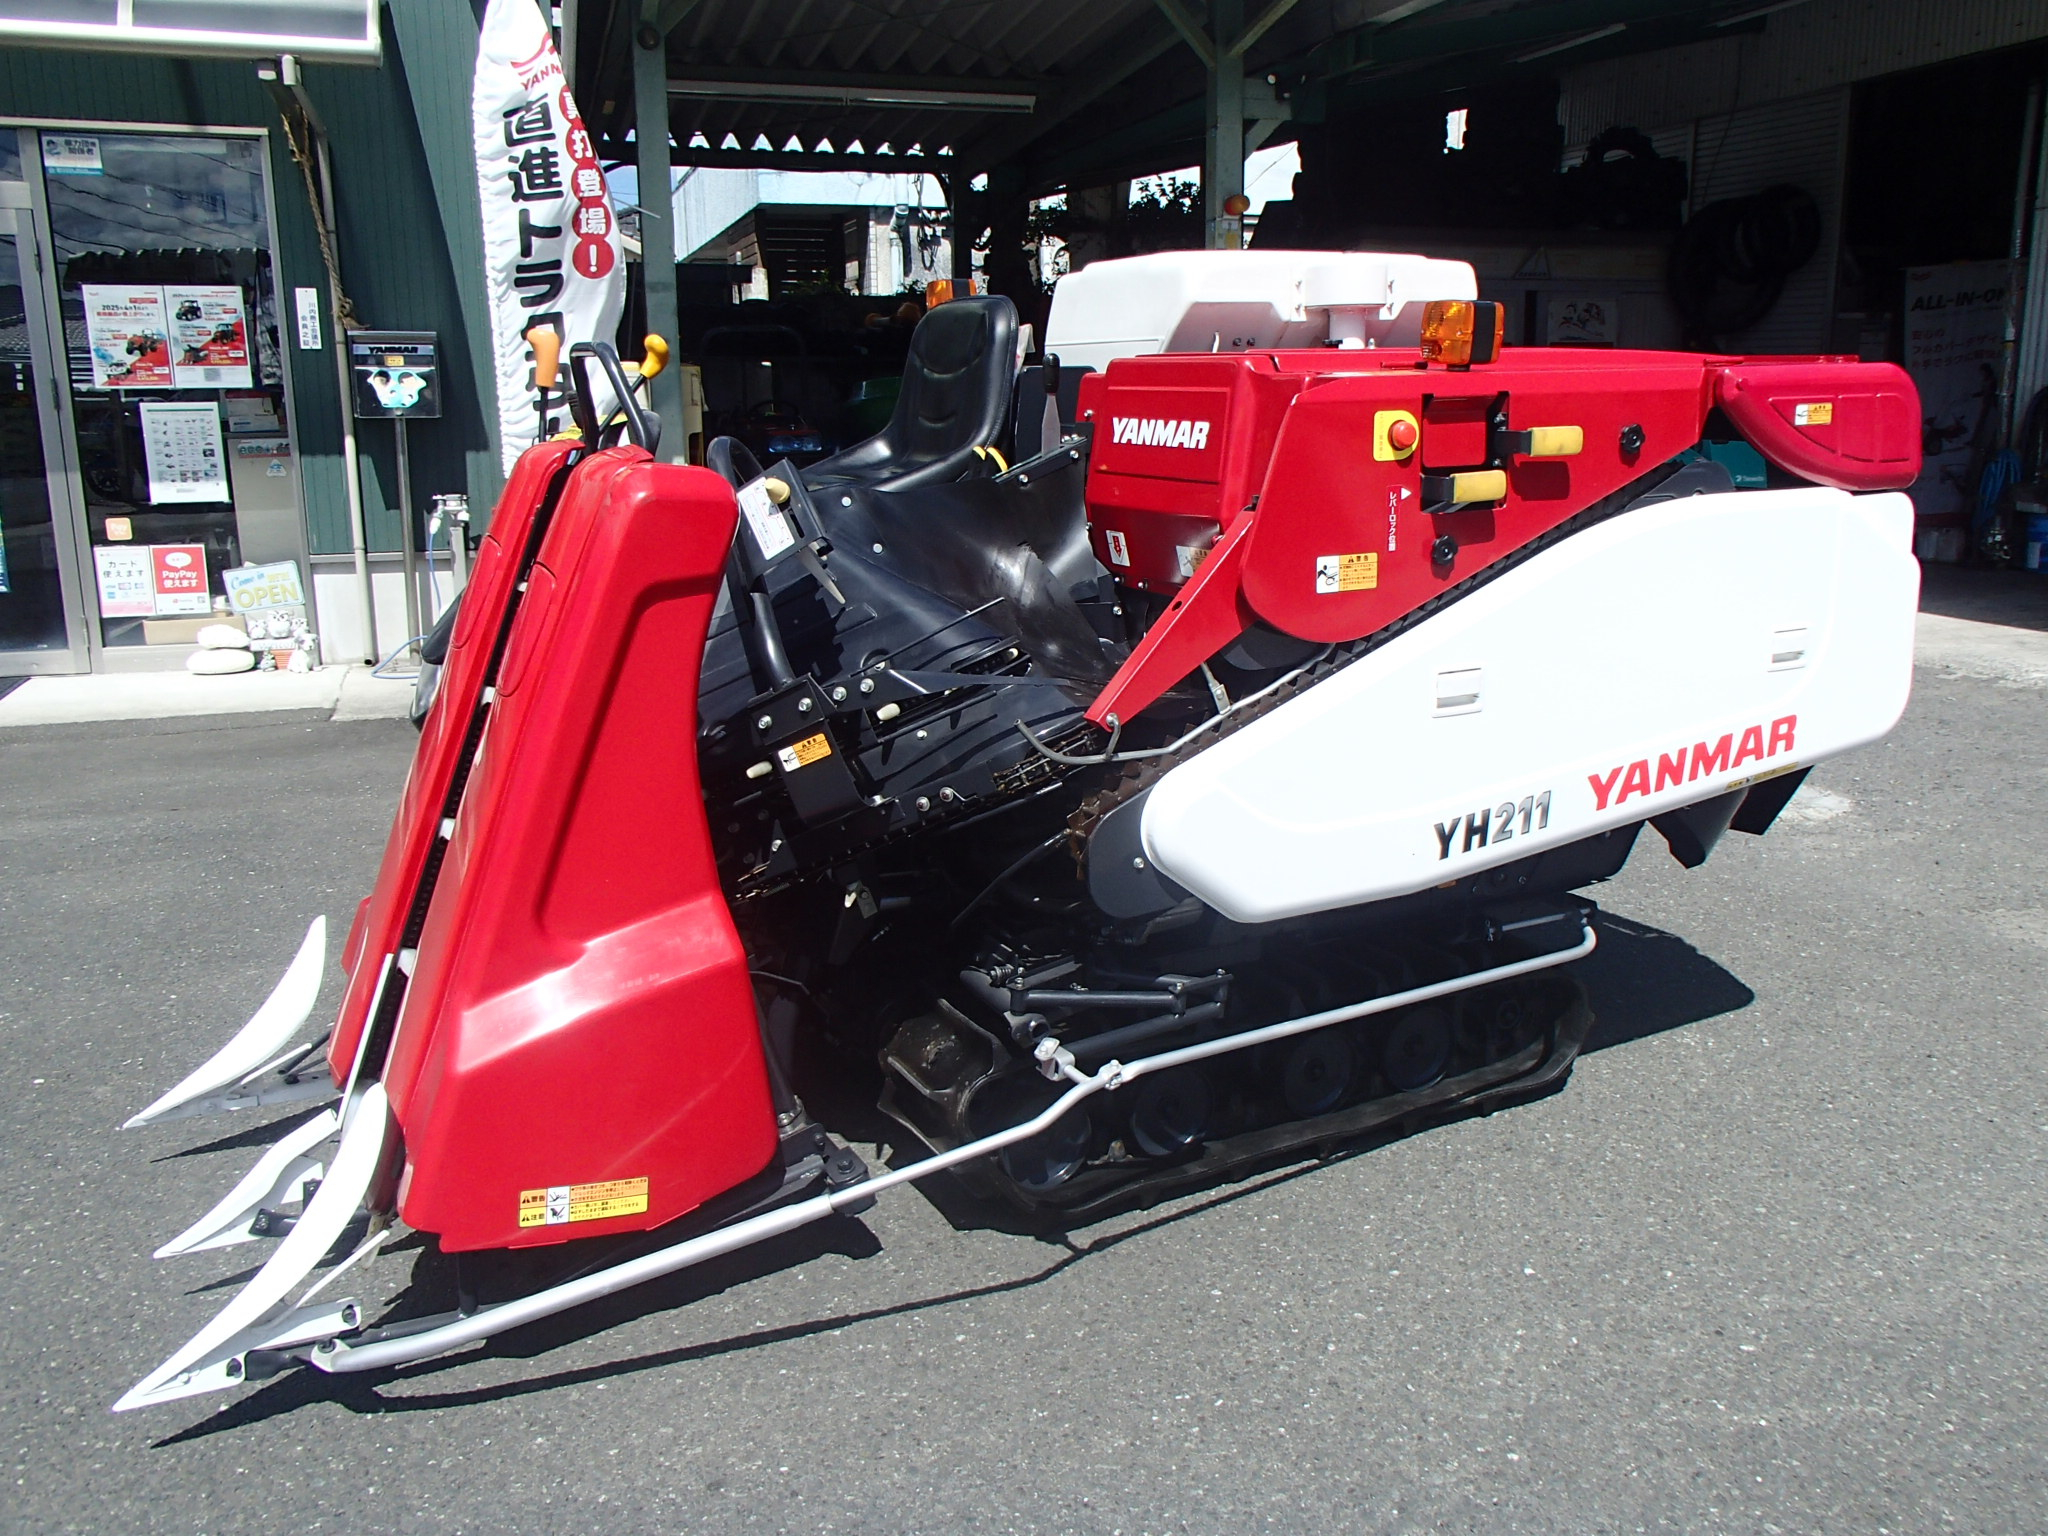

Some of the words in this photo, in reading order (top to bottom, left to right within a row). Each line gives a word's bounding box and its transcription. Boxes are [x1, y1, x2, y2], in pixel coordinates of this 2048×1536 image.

[1112, 417, 1210, 449] YANMAR
[103, 570, 144, 578] 使えます
[162, 570, 198, 579] PayPay
[163, 579, 199, 588] 使えます
[235, 582, 299, 608] OPEN
[1587, 714, 1797, 811] YANMAR
[1433, 789, 1552, 861] YH211
